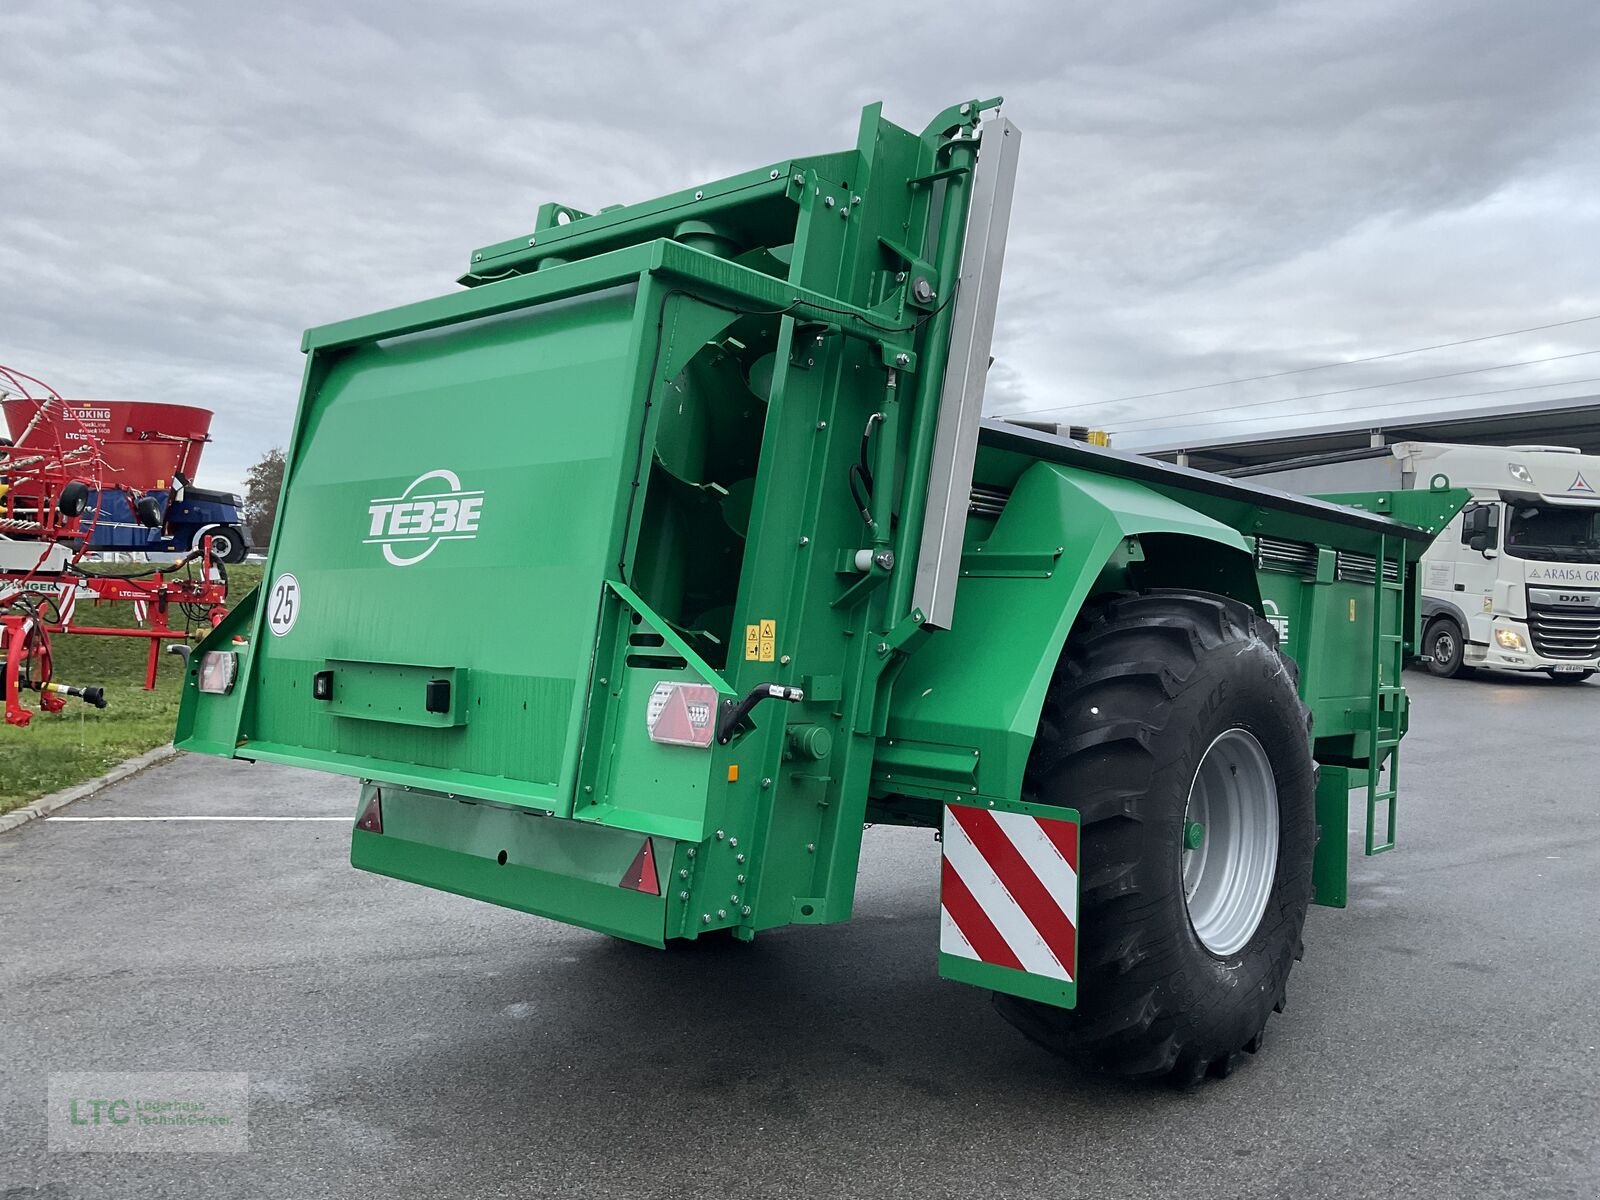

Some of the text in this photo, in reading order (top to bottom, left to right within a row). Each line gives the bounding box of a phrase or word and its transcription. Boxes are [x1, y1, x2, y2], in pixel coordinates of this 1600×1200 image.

[368, 497, 484, 537] TEBBE
[1543, 568, 1582, 580] ARAISA
[272, 585, 296, 624] 25
